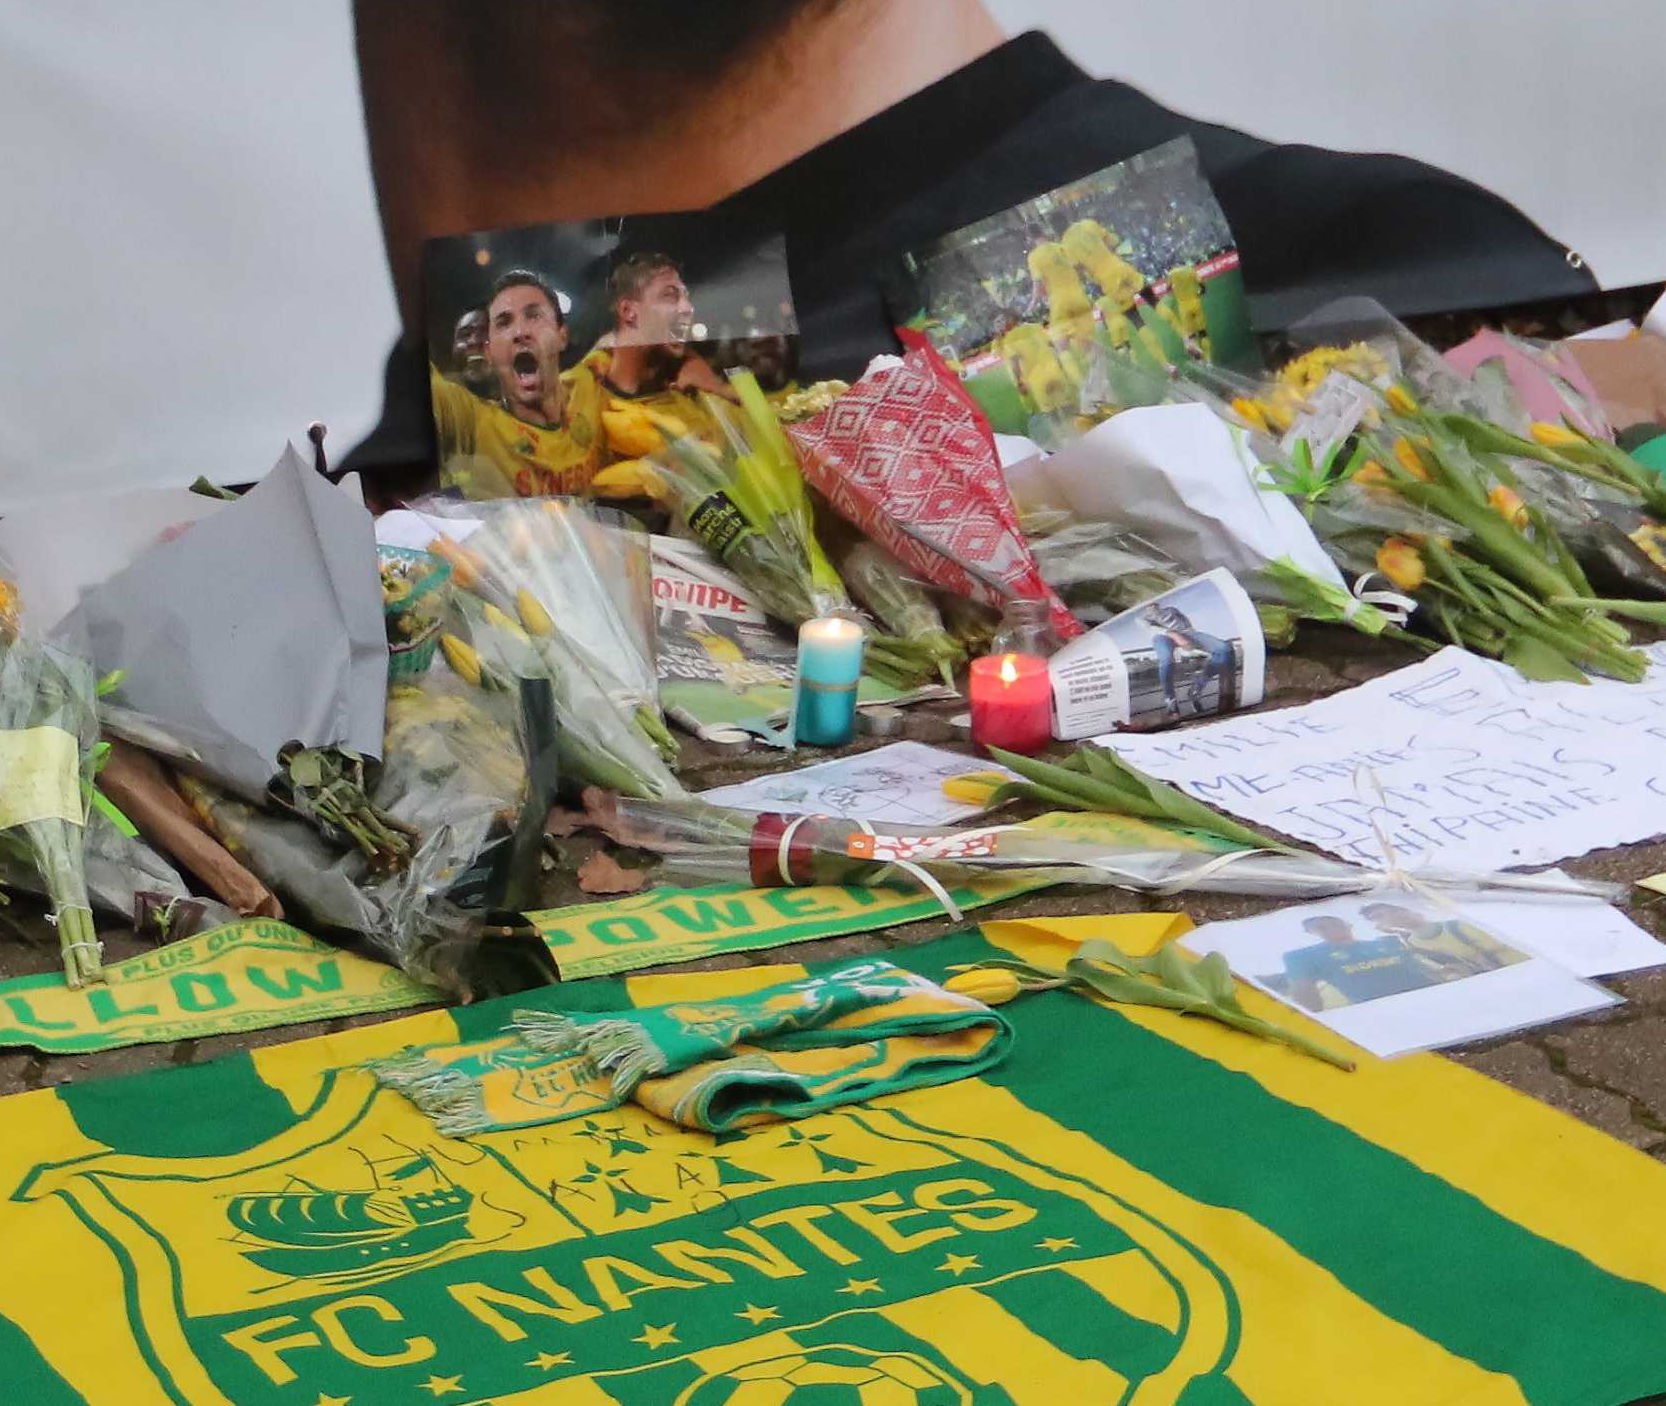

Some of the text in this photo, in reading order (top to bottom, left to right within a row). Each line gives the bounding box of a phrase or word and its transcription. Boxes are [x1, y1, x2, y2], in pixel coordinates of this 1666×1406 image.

[122, 946, 195, 979] PLUS
[221, 1178, 1039, 1387] FC NANTES
